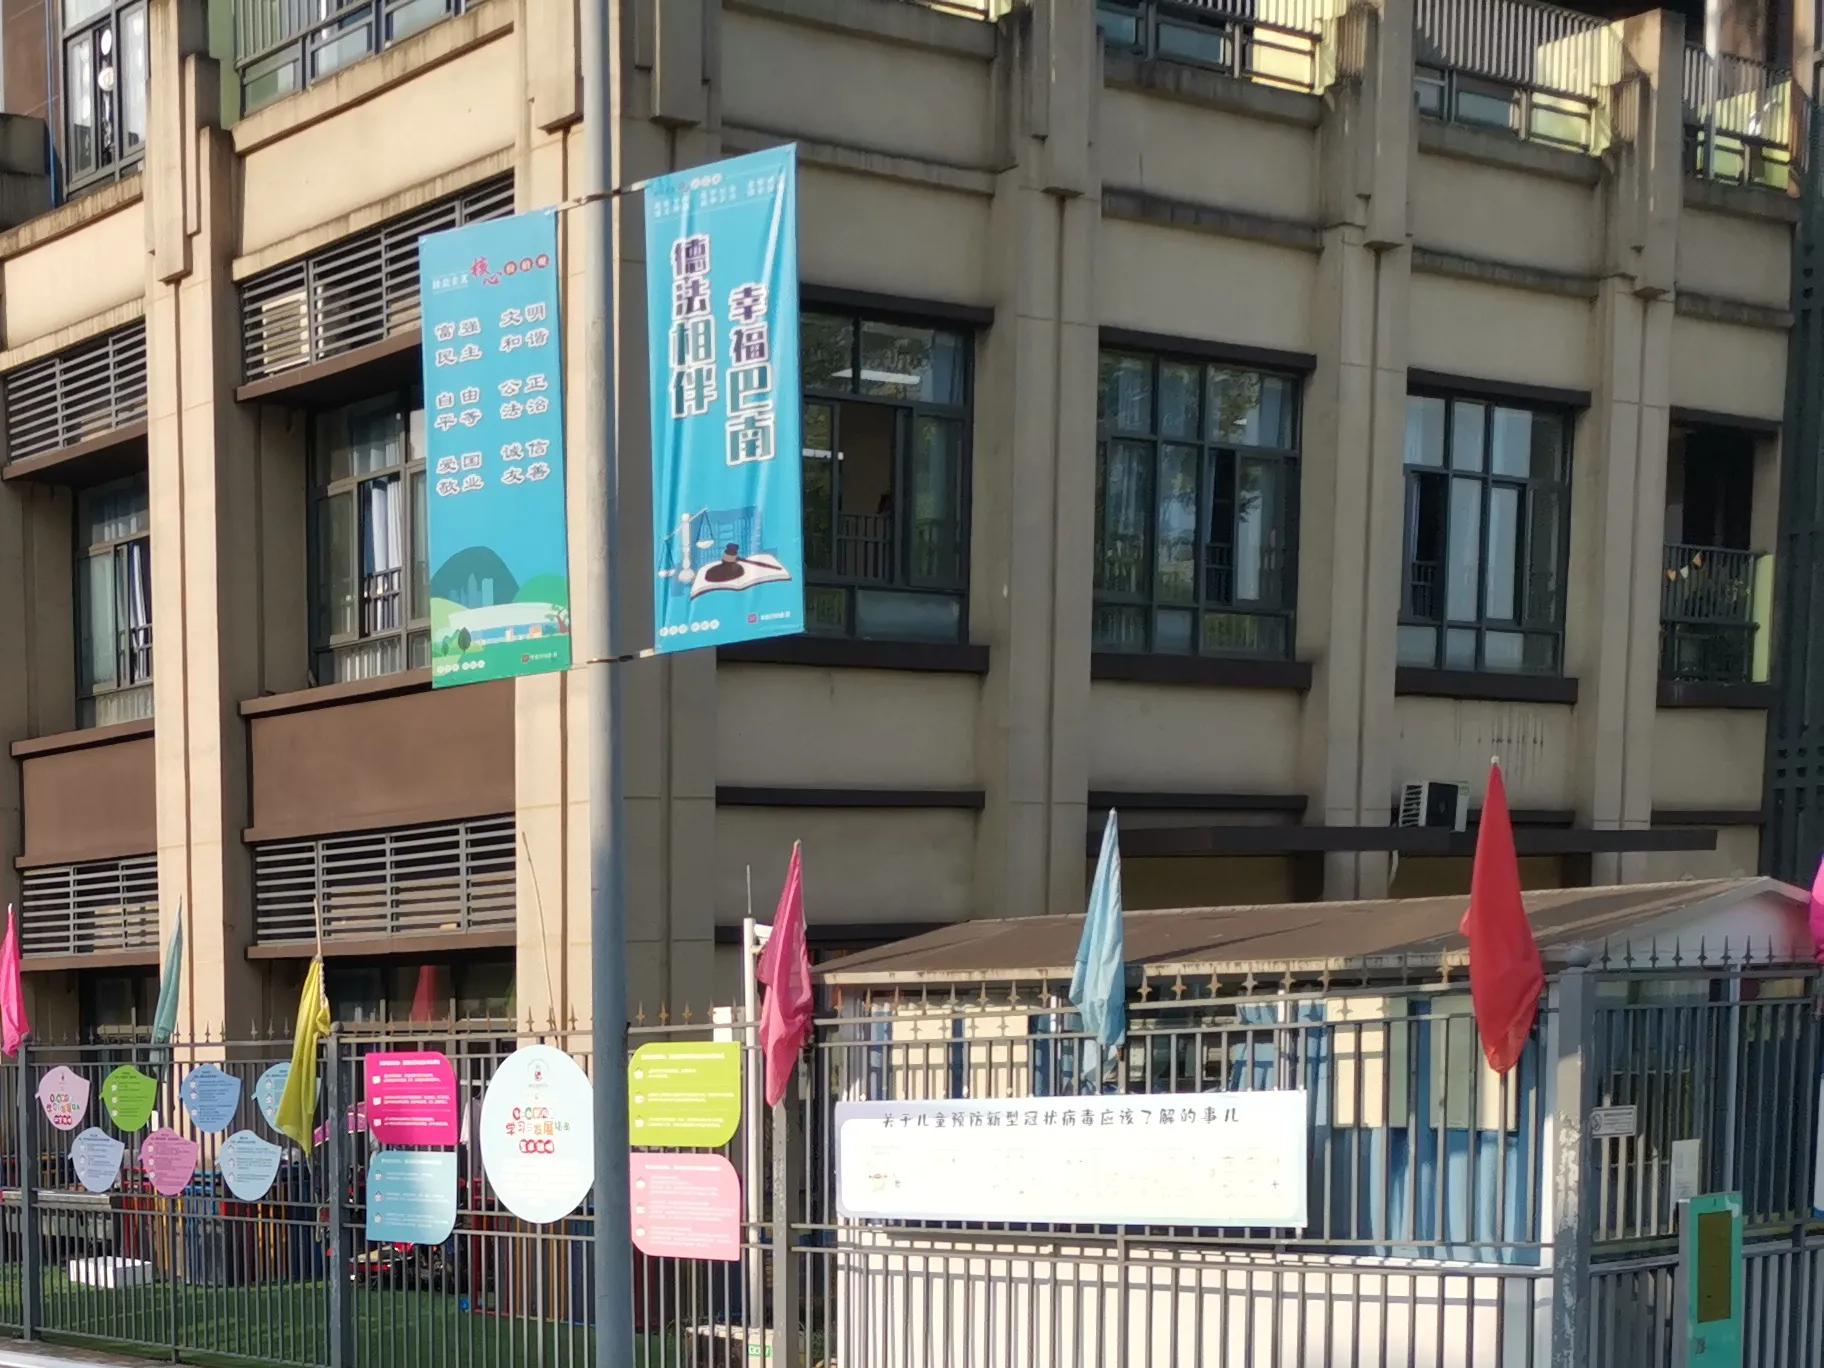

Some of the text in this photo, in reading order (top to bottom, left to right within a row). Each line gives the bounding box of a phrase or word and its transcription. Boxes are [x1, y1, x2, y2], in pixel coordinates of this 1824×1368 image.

[435, 303, 546, 342] 富强 文明
[669, 233, 717, 418] 德法相伴
[435, 328, 549, 367] 民主 和谐
[436, 374, 548, 409] 自由 公正
[726, 282, 774, 466] 幸福巴南
[435, 397, 549, 431] 平等 法治
[436, 439, 550, 474] 爱国 诚信
[437, 462, 550, 497] 敬业 友善
[881, 1104, 1240, 1130] 关于儿童预防新型冠状病毒应该了解的事儿
